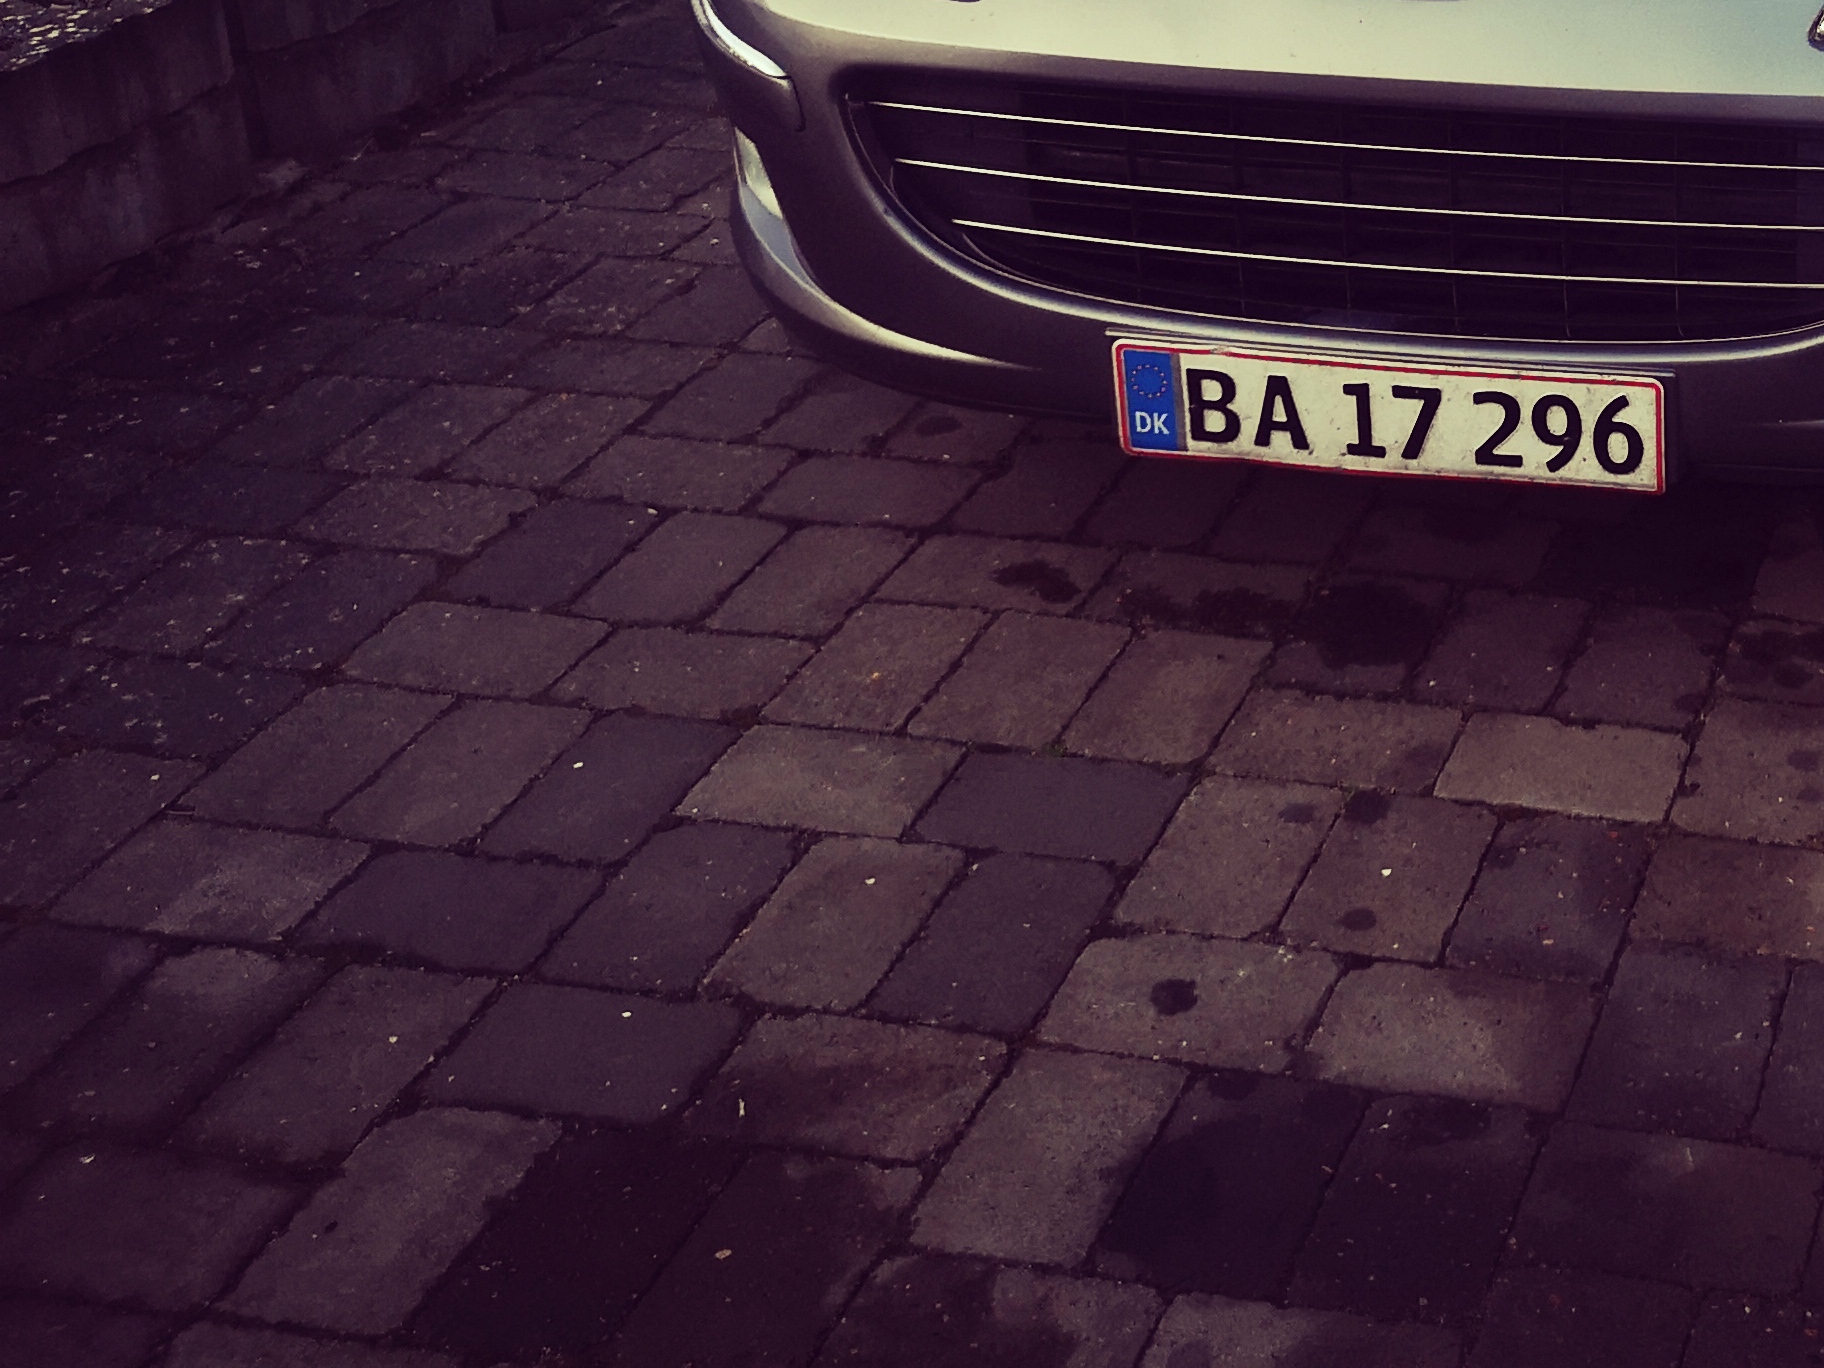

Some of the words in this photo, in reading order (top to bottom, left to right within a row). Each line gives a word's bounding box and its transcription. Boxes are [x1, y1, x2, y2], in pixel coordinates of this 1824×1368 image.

[1134, 410, 1170, 435] DK
[1185, 367, 1310, 451] BA
[1342, 382, 1442, 460] 17
[1472, 390, 1645, 475] 296
